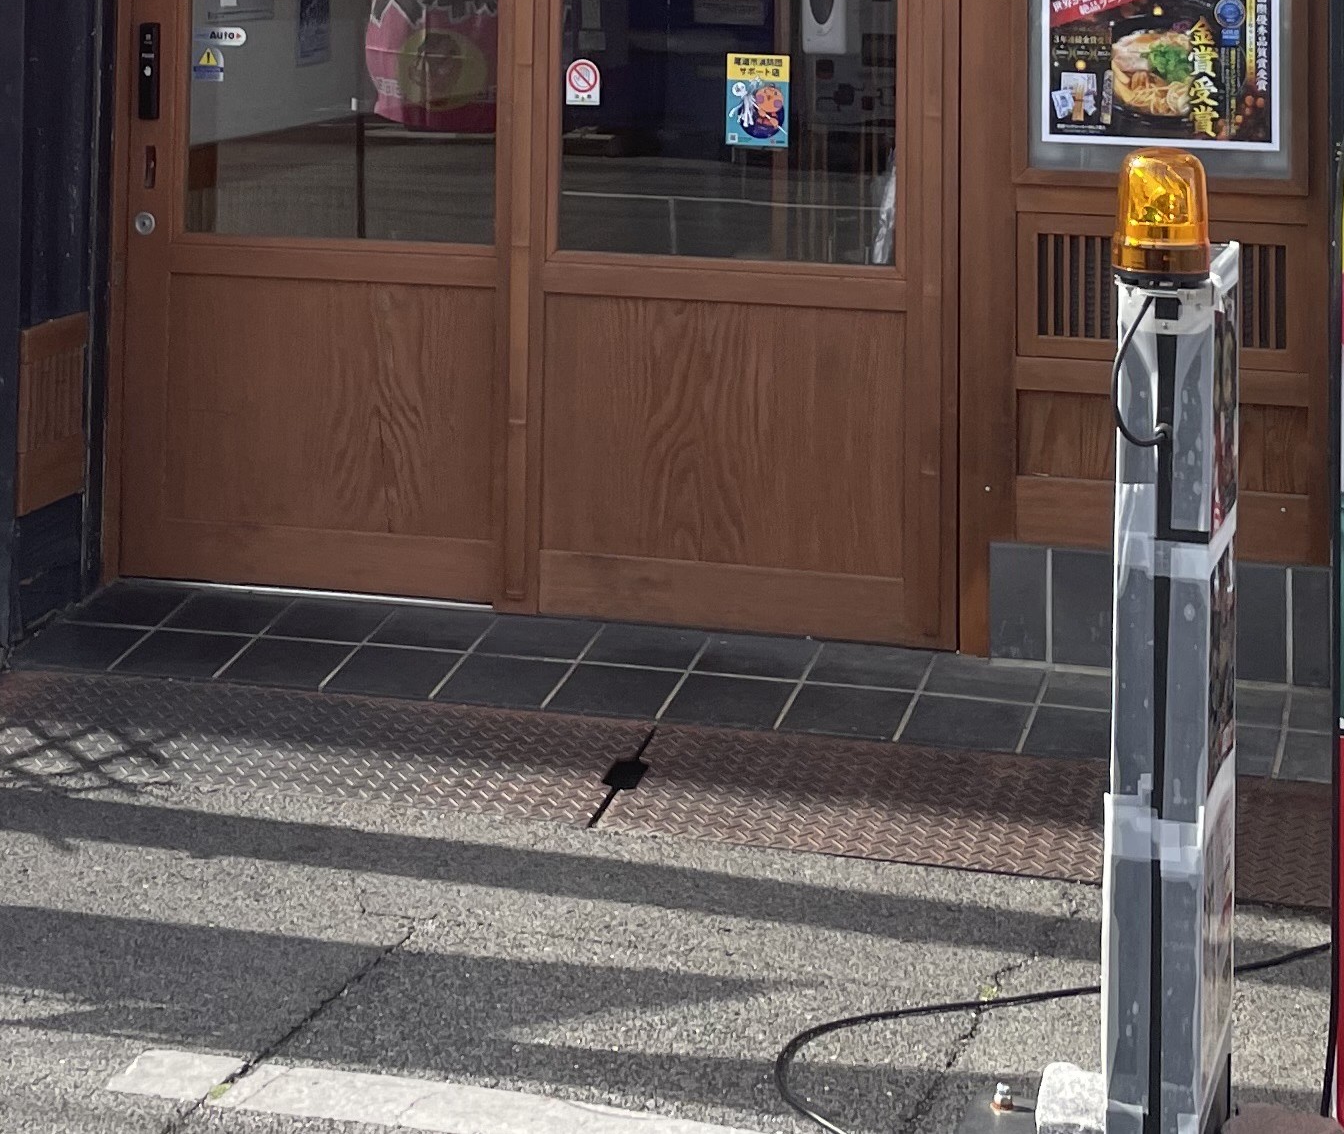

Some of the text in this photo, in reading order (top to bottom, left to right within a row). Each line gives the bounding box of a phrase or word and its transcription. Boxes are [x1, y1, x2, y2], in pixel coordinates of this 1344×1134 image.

[209, 30, 235, 39] Auto
[1187, 15, 1220, 138] 金賞受賞
